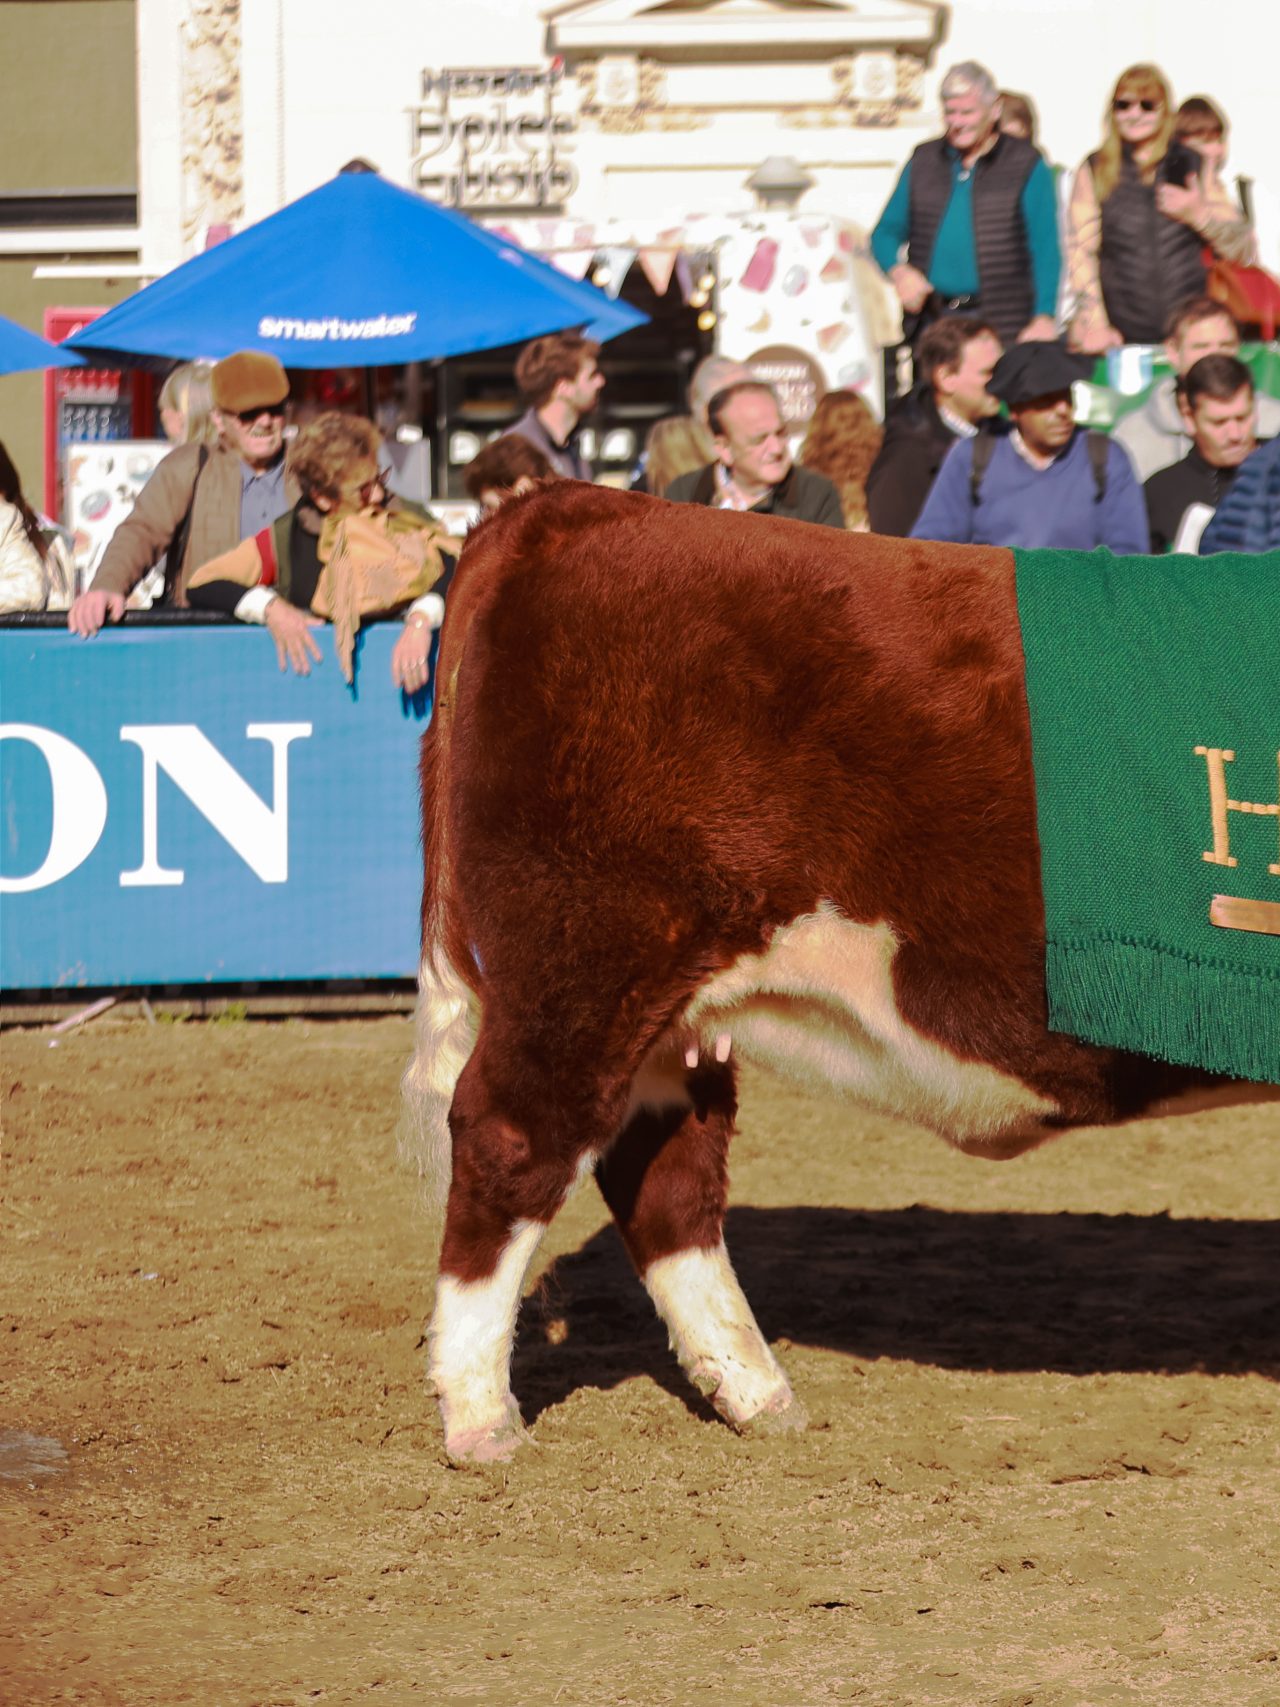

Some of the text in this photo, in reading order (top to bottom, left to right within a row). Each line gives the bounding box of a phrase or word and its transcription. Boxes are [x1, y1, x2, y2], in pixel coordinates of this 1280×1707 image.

[404, 103, 578, 157] Dolce
[257, 311, 418, 342] smartwater
[0, 722, 313, 893] ON
